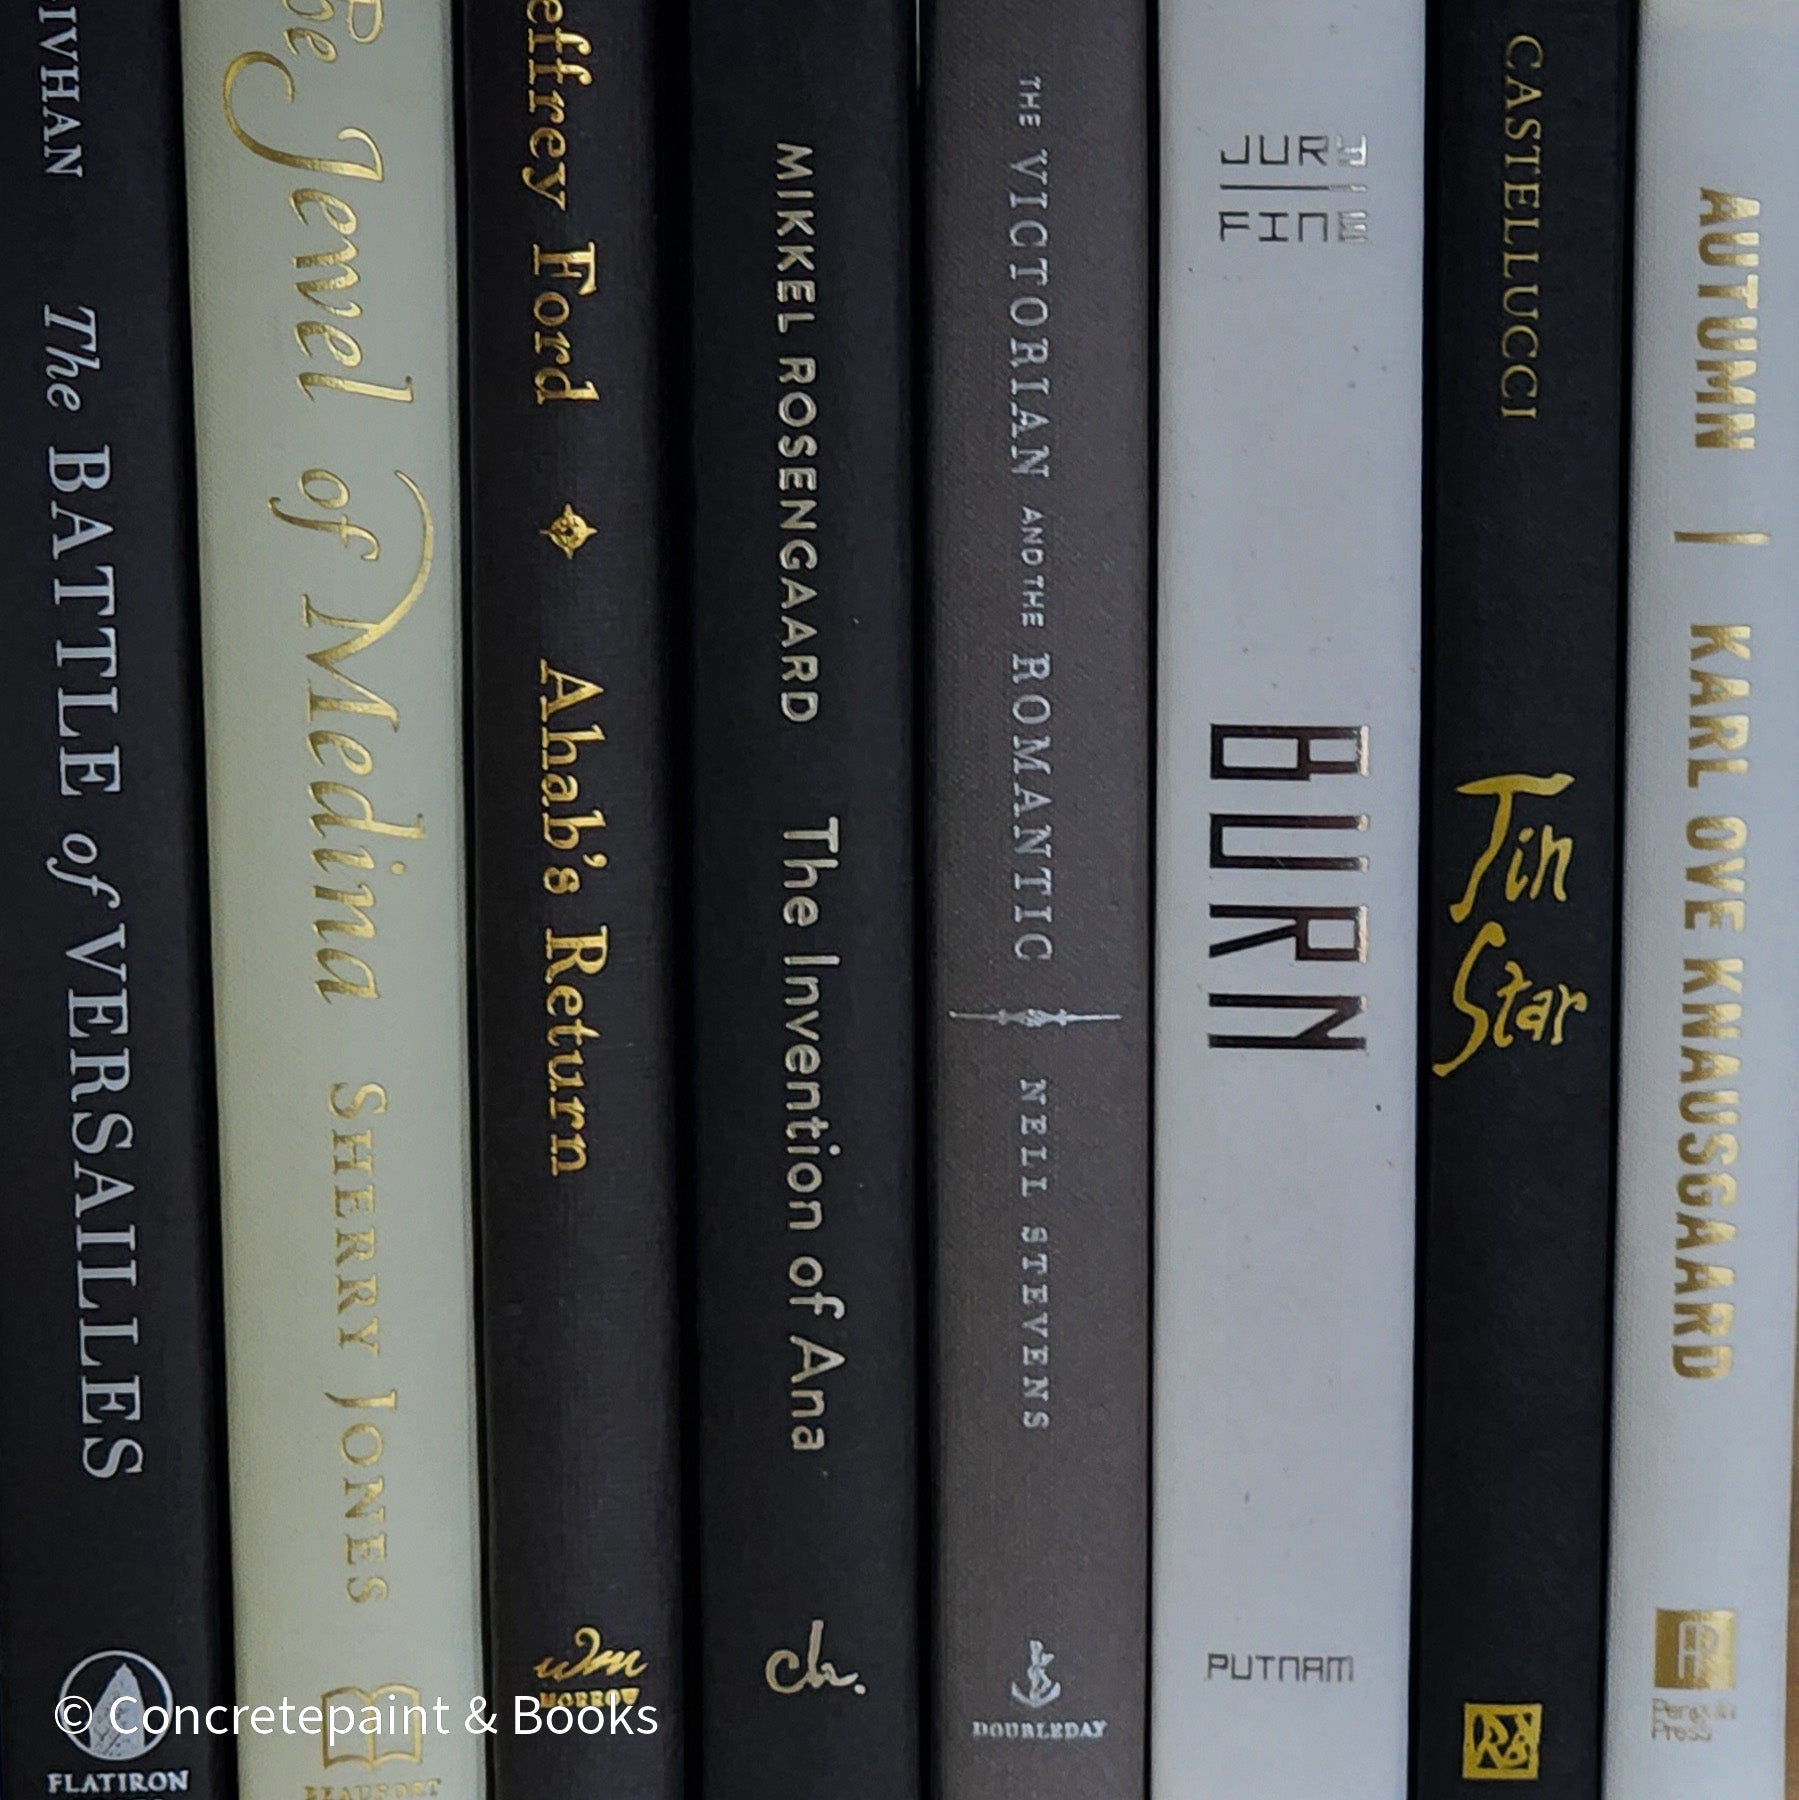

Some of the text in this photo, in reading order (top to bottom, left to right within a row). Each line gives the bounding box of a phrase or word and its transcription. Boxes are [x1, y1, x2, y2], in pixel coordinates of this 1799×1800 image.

[38, 0, 83, 178] IVHAN
[222, 50, 415, 404] Jewel
[1500, 34, 1543, 420] CASTELLUCCI
[532, 241, 600, 406] Ford
[776, 143, 819, 723] MIKKEL ROSENGAARD
[267, 468, 381, 562] of
[1009, 75, 1053, 961] THE VICTORIAN AND THE ROMANTIC
[44, 304, 144, 1479] The BATTLE of VERSAILLES
[300, 468, 435, 1006] Medina
[1209, 724, 1370, 1050] BURN
[1449, 772, 1574, 924] Tin
[1671, 186, 1761, 1381] AUTUMN KARL OVE KNAUSGAARD
[539, 659, 608, 1176] Ahab's Return
[1432, 921, 1588, 1077] Star
[783, 816, 846, 1453] The Invention of Ana
[1019, 1078, 1050, 1429] NELL STEVENS
[324, 1081, 398, 1604] SHERRY JONES
[47, 1769, 191, 1794] FLATIRON
[972, 1720, 1108, 1739] DOUBLEDAY
[1206, 1652, 1355, 1683] PUTNAM
